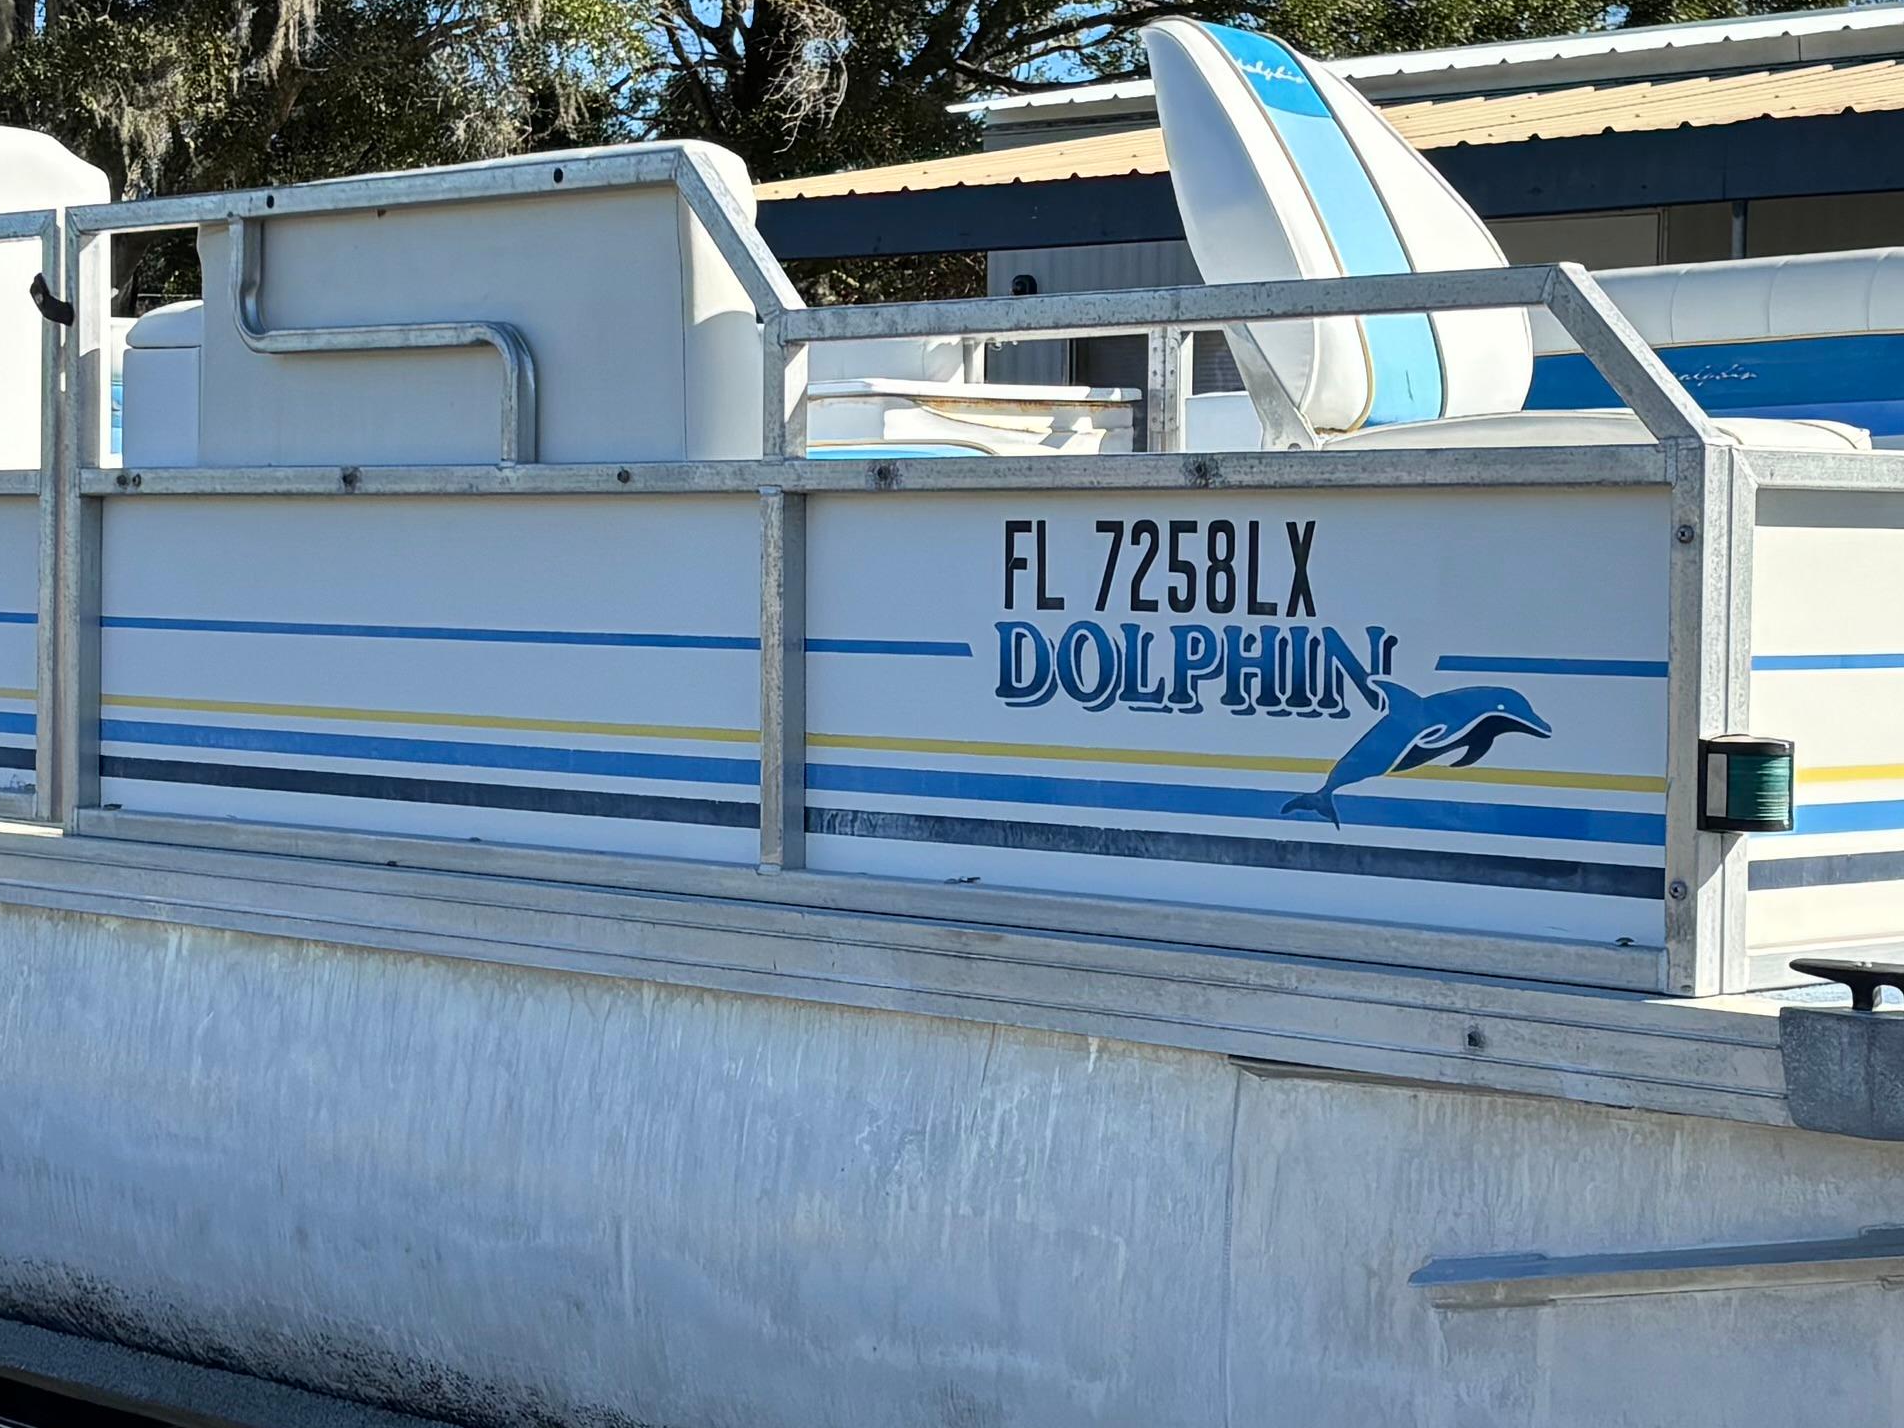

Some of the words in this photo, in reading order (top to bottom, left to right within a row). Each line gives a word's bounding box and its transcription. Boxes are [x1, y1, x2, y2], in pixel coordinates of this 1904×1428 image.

[1003, 520, 1065, 611] FL
[1095, 520, 1317, 617] 7258LX
[994, 620, 1398, 719] DOLPHIN
